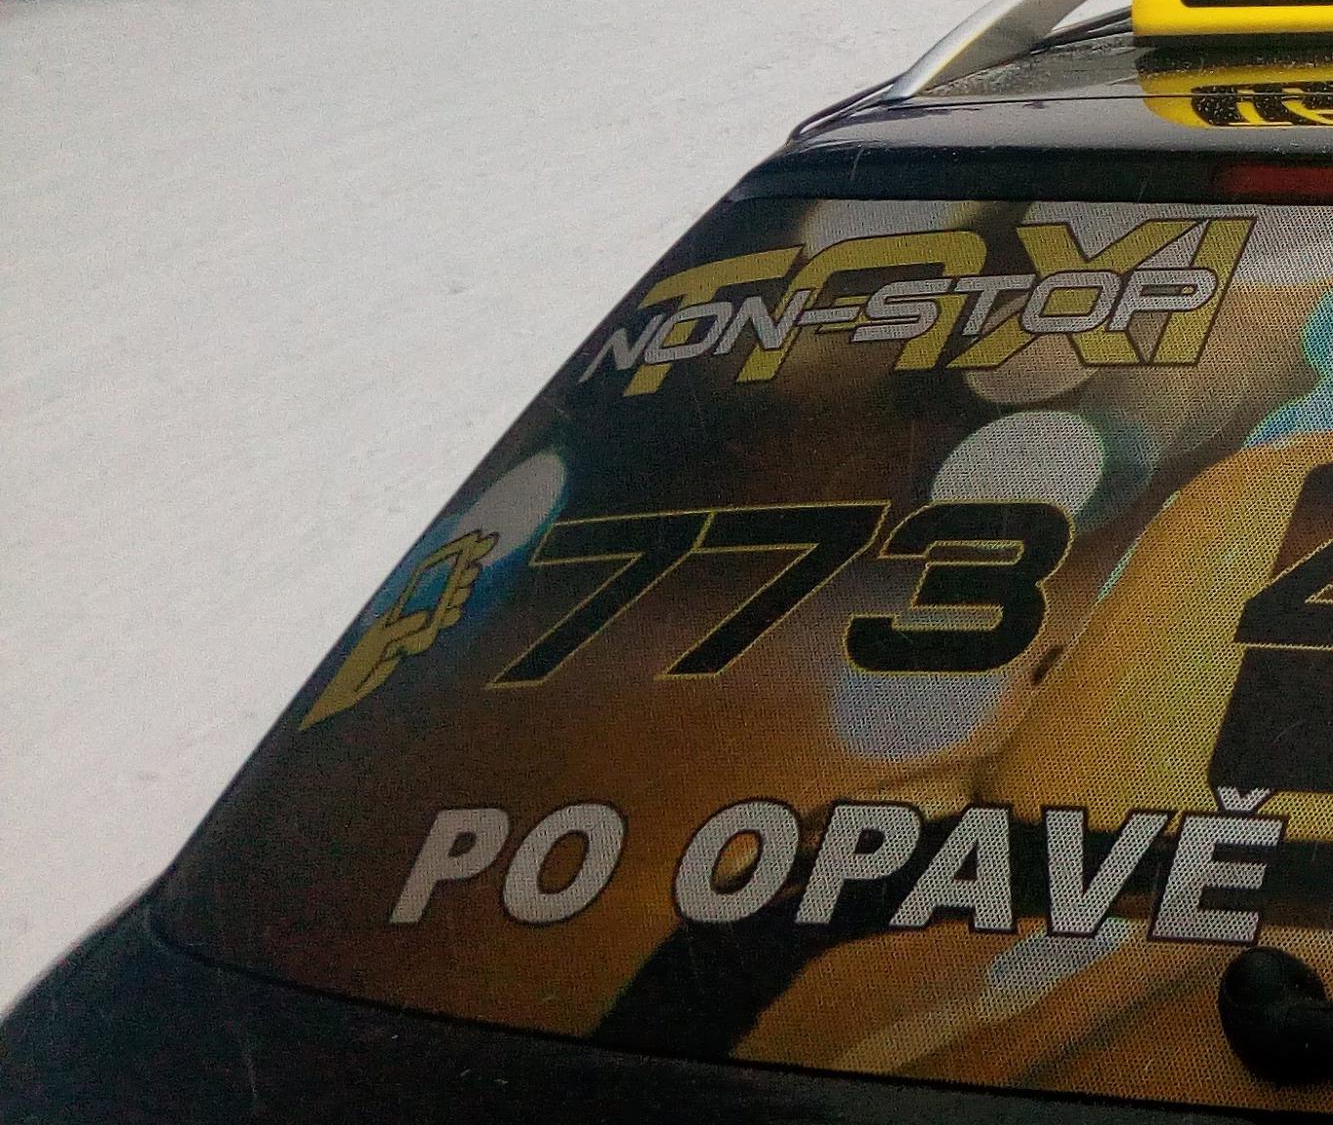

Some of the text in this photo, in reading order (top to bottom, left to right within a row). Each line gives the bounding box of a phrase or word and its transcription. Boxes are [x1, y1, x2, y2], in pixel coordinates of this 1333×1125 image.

[580, 269, 1219, 379] NON-STOP
[622, 216, 1258, 397] TAXI
[484, 500, 1076, 689] 773
[390, 802, 627, 928] PO
[672, 785, 1287, 945] OPAVĚ
